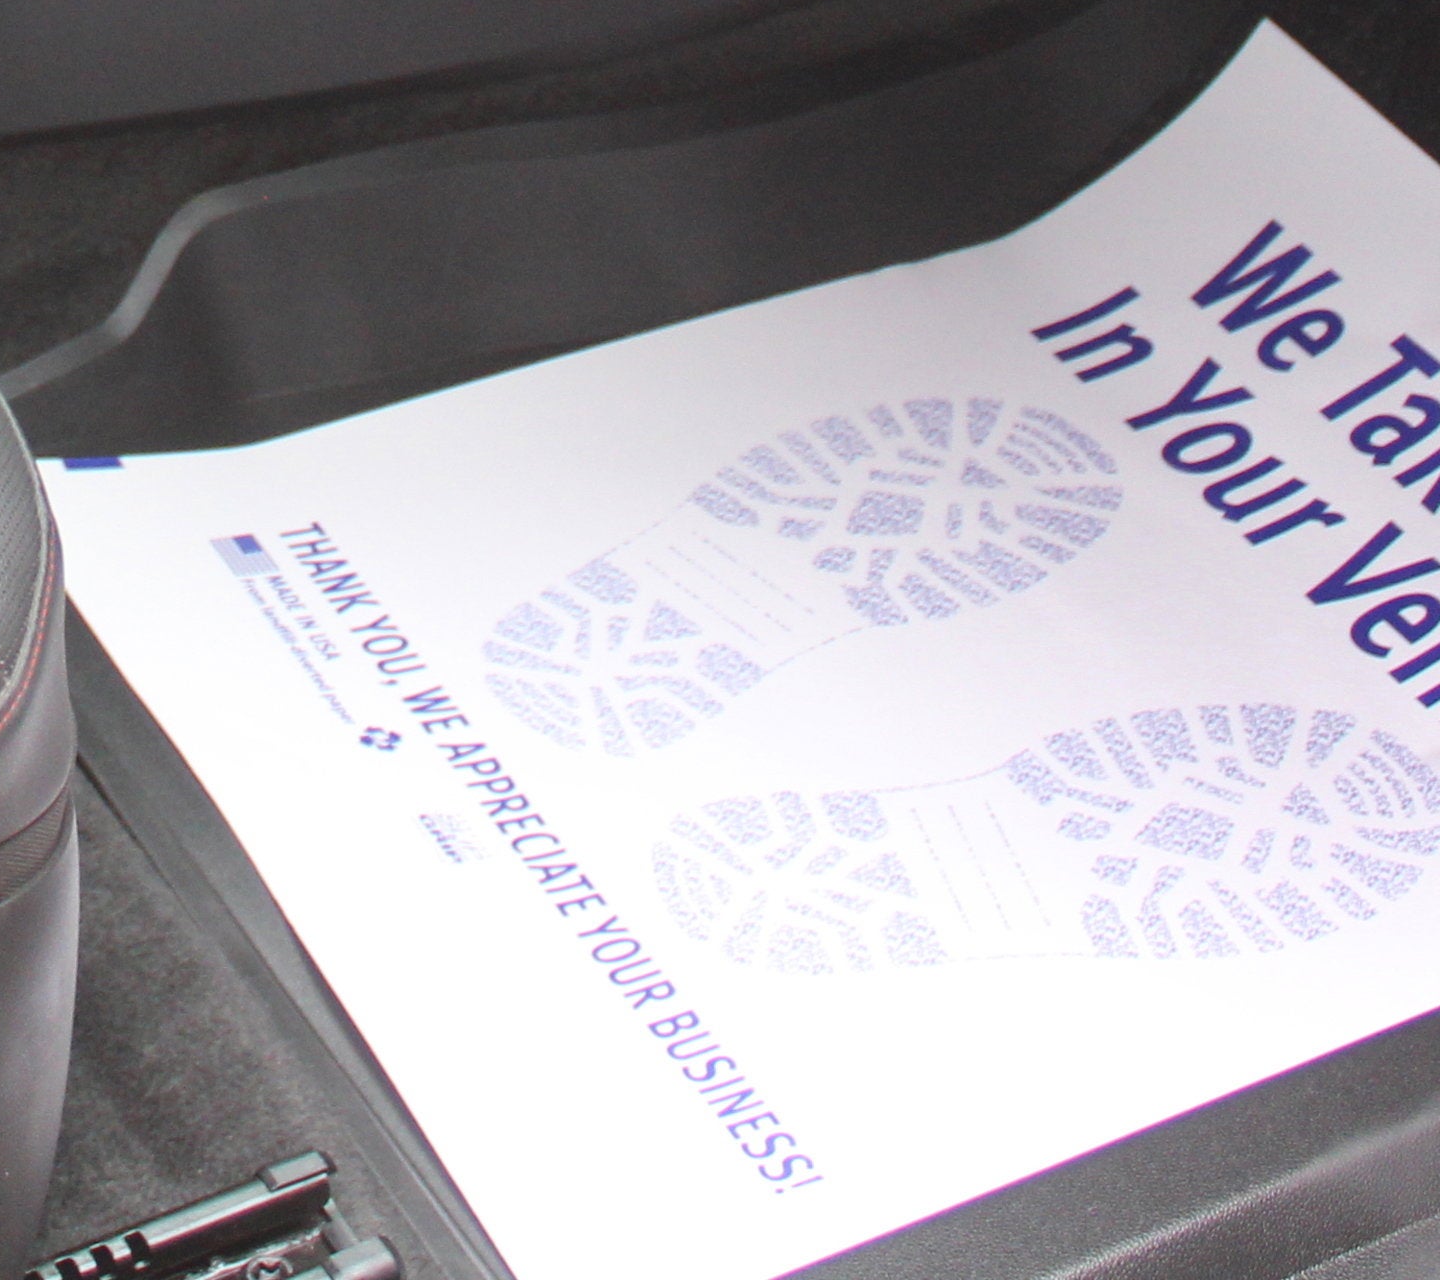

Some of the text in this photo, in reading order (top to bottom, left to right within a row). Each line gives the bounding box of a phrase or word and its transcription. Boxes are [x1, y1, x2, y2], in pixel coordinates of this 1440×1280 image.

[1190, 220, 1345, 372] We
[1030, 286, 1153, 383] In
[1125, 357, 1344, 546] Your
[266, 575, 341, 661] MADE IN USA
[279, 522, 380, 614] THANK
[350, 615, 425, 686] YOU,
[403, 686, 469, 734] WE
[438, 743, 605, 917] APPRECIATE
[578, 915, 675, 1009] YOUR
[648, 1010, 822, 1193] BUSINESS!
